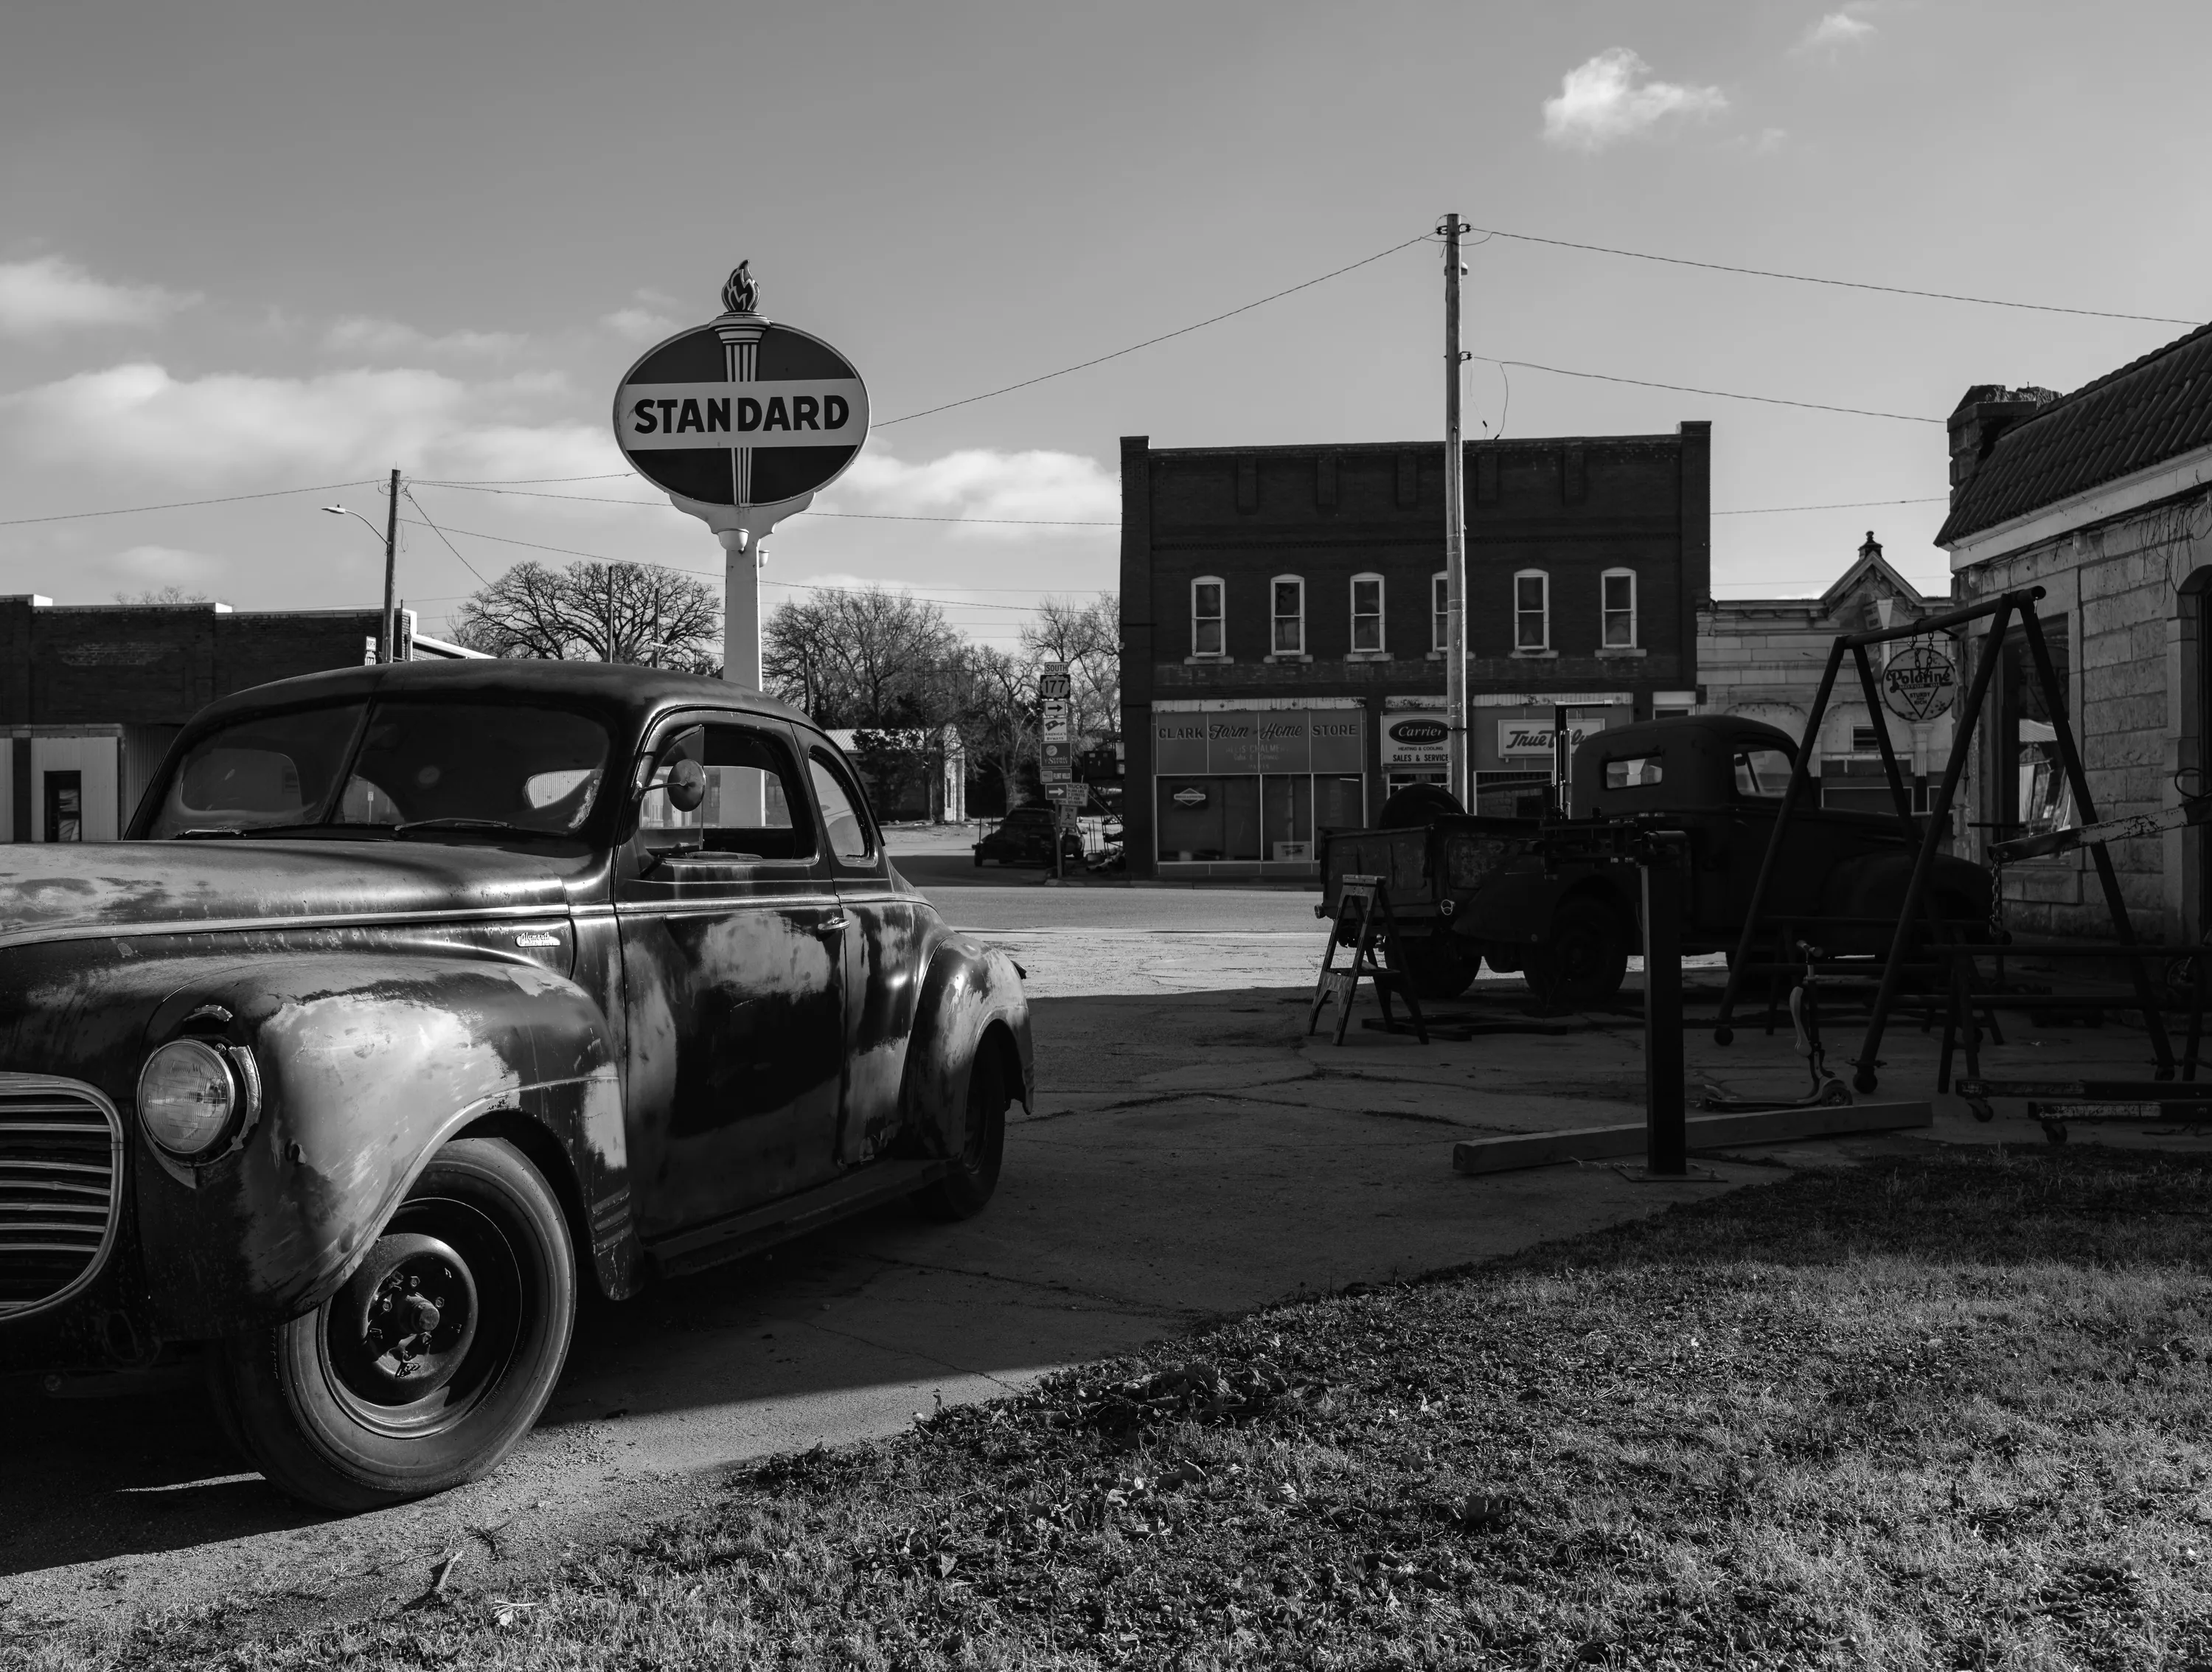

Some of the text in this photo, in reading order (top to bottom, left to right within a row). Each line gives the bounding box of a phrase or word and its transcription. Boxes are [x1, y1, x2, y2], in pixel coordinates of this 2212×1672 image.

[634, 395, 849, 434] STANDARD
[1046, 664, 1067, 672] SOUTH
[1045, 680, 1065, 694] 177
[1886, 669, 1950, 693] Polarine
[1158, 727, 1204, 740] CLARK
[1208, 724, 1249, 740] Farm
[1260, 723, 1303, 740] Home
[1312, 725, 1359, 738] STORE
[1398, 726, 1442, 737] Carrier
[1506, 729, 1548, 749] True
[1048, 755, 1068, 764] Scenic
[1393, 754, 1449, 762] SALES & SERVICE
